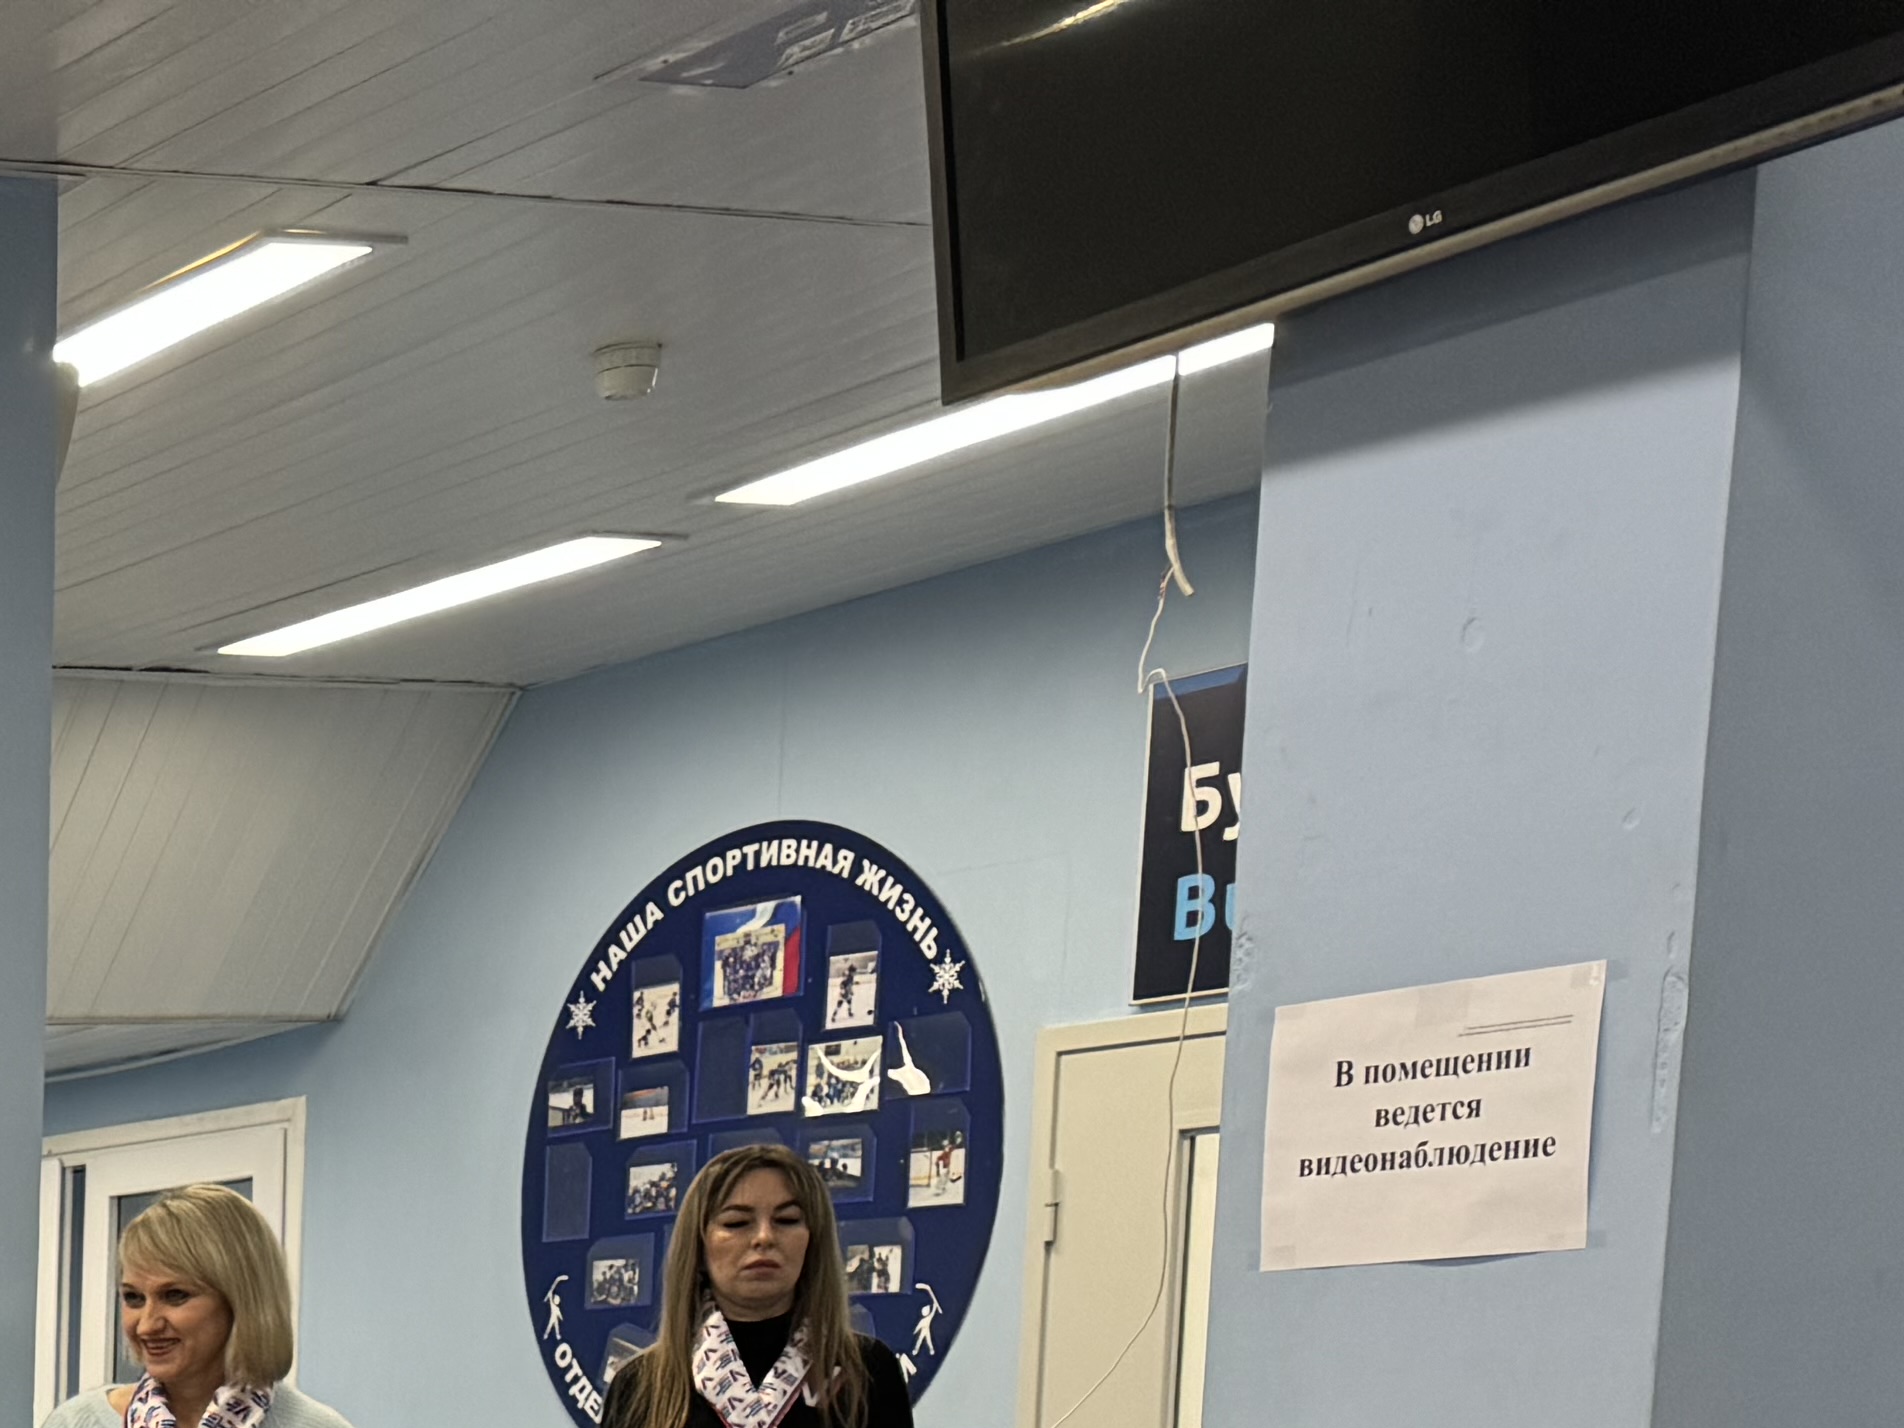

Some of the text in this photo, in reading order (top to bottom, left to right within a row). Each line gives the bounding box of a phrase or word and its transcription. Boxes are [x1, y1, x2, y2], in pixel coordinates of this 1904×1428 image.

[590, 838, 939, 992] НАША СПОРТИВНАЯ ЖИЗНЬ
[1334, 1047, 1532, 1088] В помещении
[1374, 1098, 1483, 1129] ведется
[1299, 1135, 1557, 1178] видеонаблюдение
